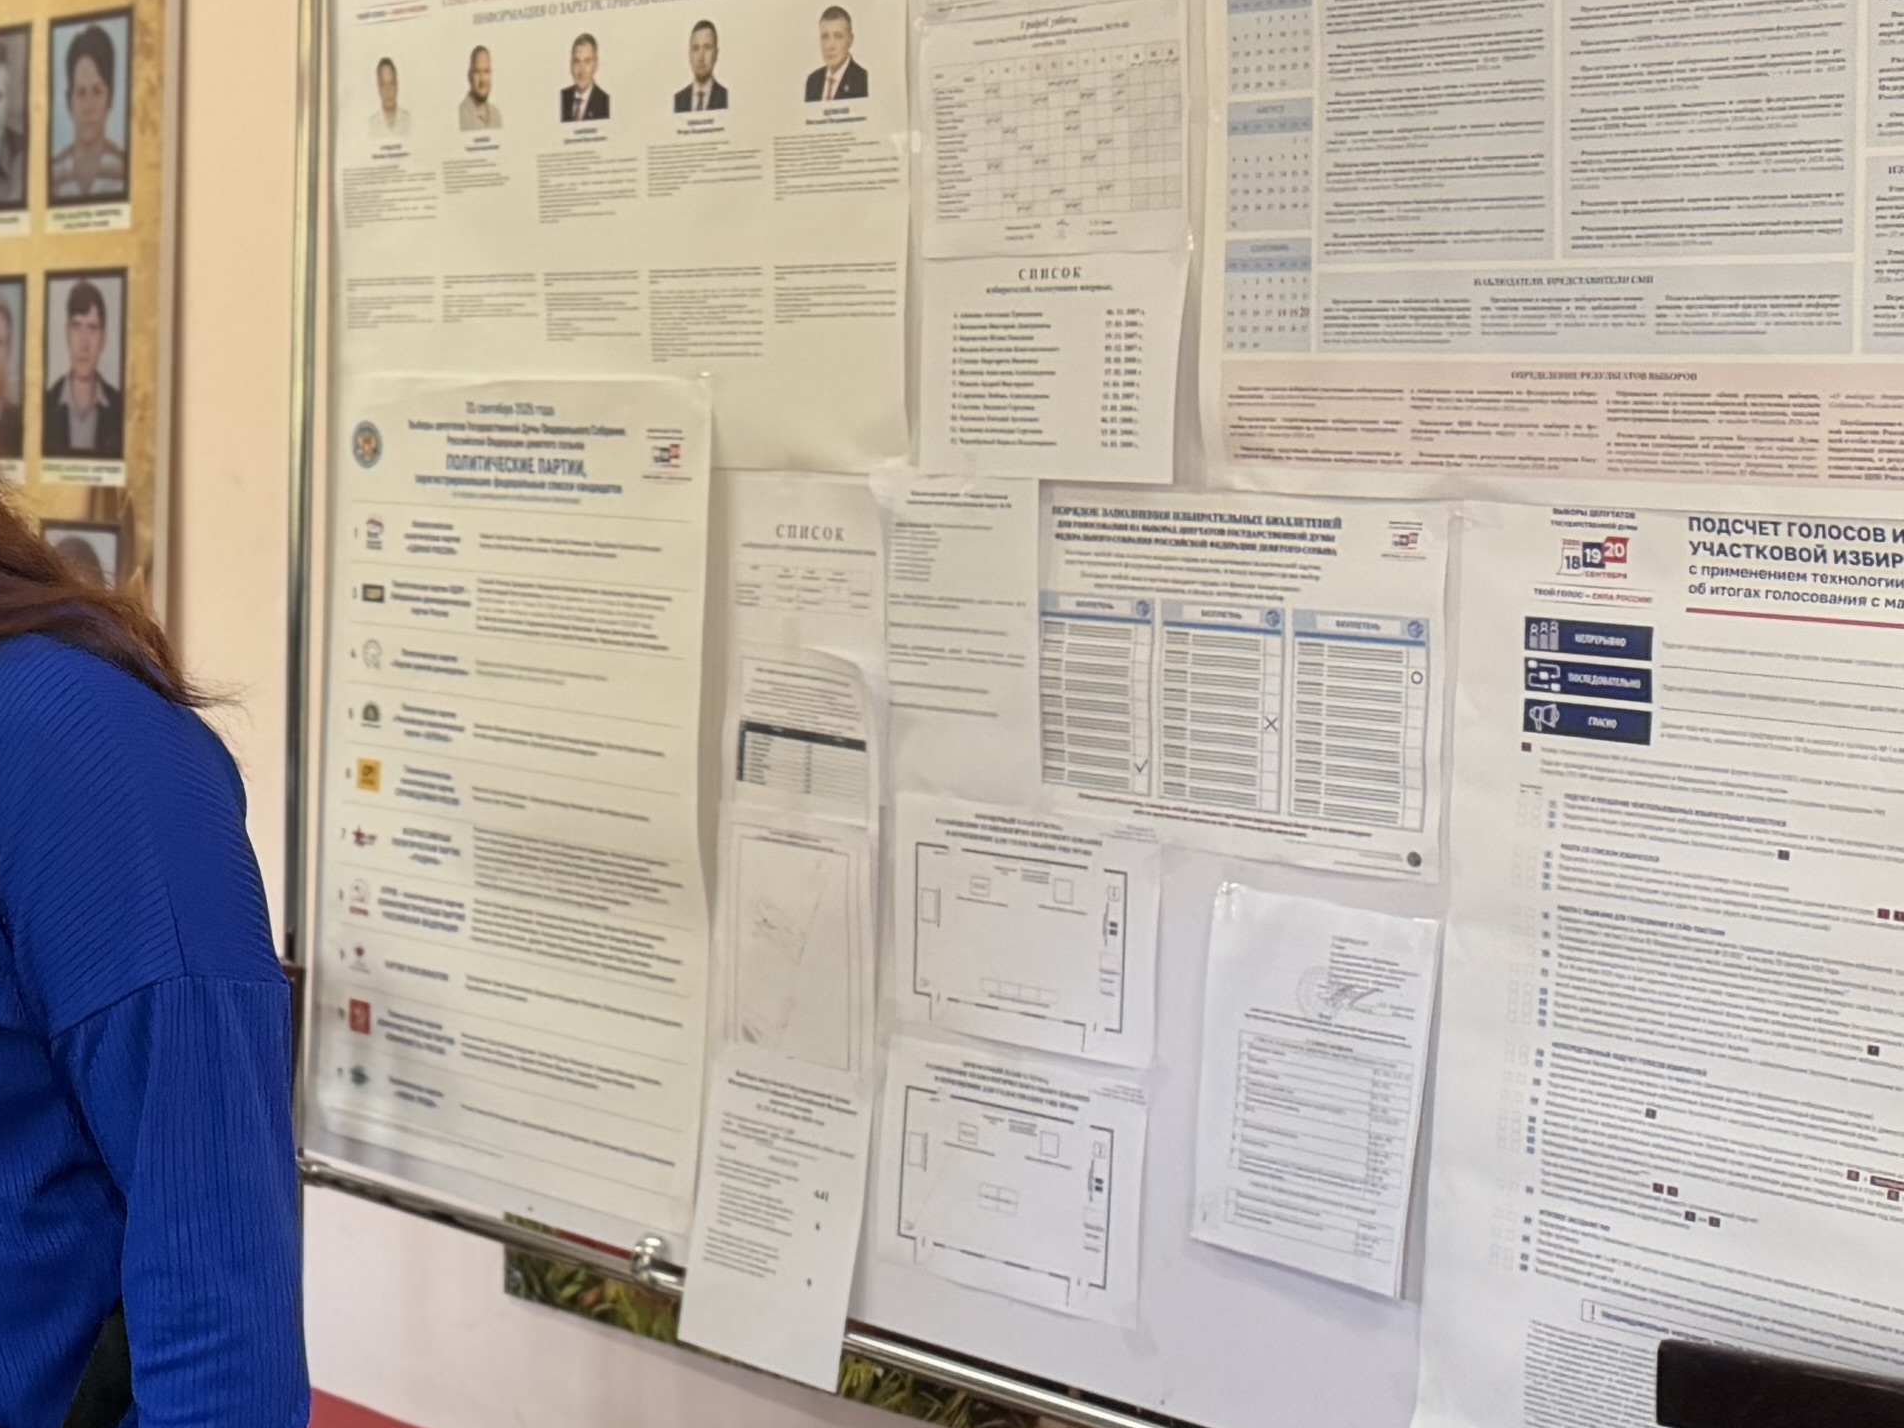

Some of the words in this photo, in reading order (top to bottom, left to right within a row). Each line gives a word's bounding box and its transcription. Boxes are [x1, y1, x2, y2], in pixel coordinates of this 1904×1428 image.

[1018, 266, 1082, 280] СПИСОК
[1299, 306, 1310, 318] 20
[446, 454, 534, 474] ПОЛИТИЧЕСКИЕ
[776, 524, 845, 542] СПИСОК
[1688, 516, 1782, 537] ПОДСЧЕТ
[1787, 522, 1886, 543] ГОЛОСОВ
[1564, 555, 1581, 570] 18
[1584, 548, 1602, 564] 19
[1603, 542, 1625, 558] 20
[1688, 541, 1827, 565] УЧАСТКОВОЙ
[1688, 564, 1698, 575] с
[1701, 565, 1807, 583] применением
[1688, 582, 1706, 595] об
[1710, 584, 1760, 599] итогах
[1765, 589, 1866, 607] голосования
[1871, 596, 1880, 608] с
[1574, 633, 1627, 647] НЕПРЕРЫВНО
[1567, 672, 1641, 689] ПОСЛЕДОВАТЕЛЬНО
[1588, 716, 1618, 729] ГЛАСНО
